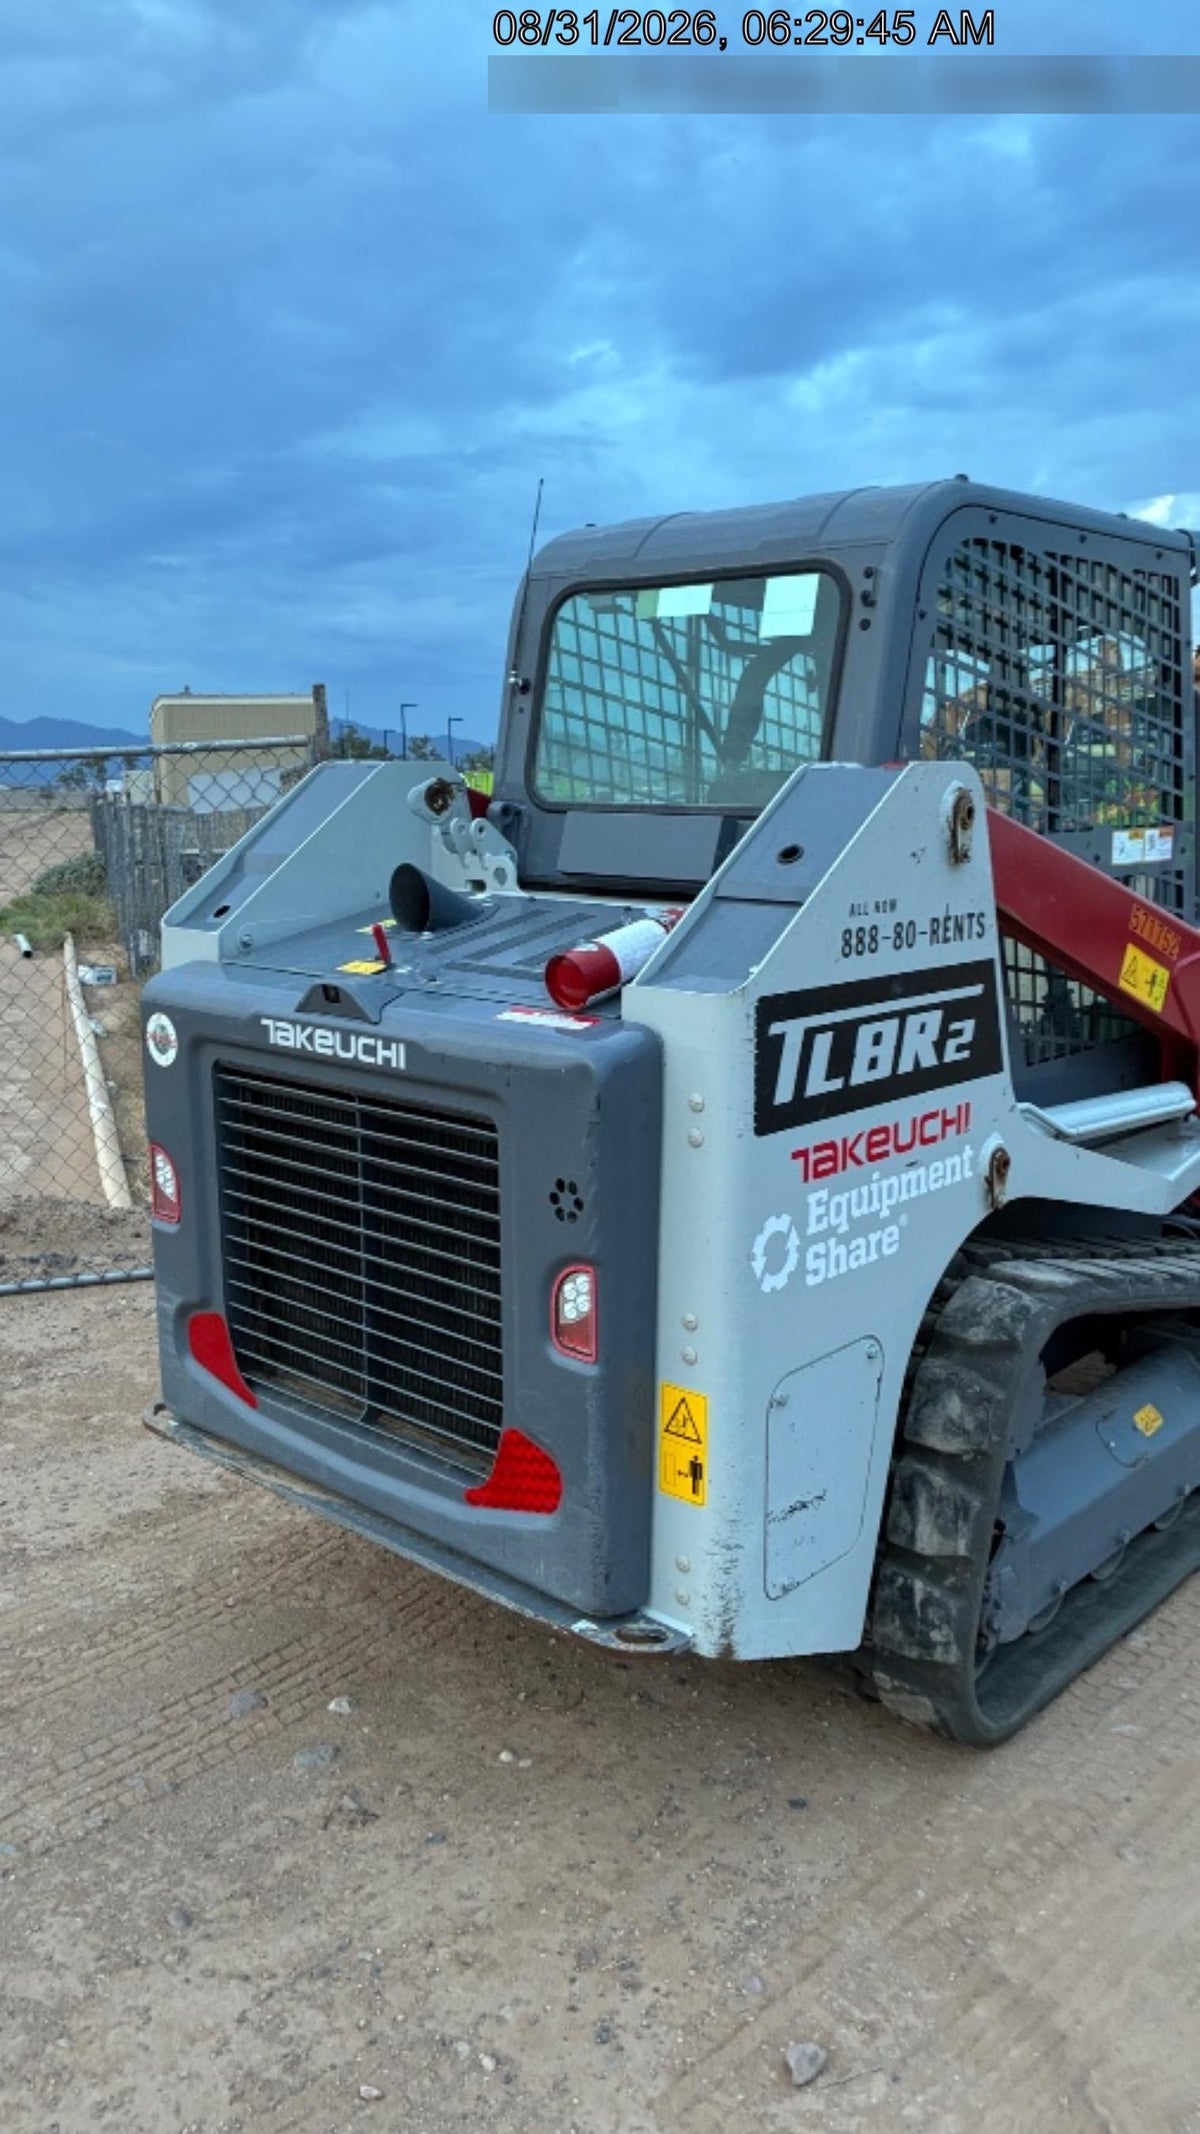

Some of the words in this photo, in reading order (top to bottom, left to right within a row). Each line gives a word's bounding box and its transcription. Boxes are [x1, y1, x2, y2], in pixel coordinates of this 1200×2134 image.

[841, 912, 986, 959] 888-80-RENTS
[806, 1144, 974, 1236] Equipment
[805, 1225, 900, 1286] Share
